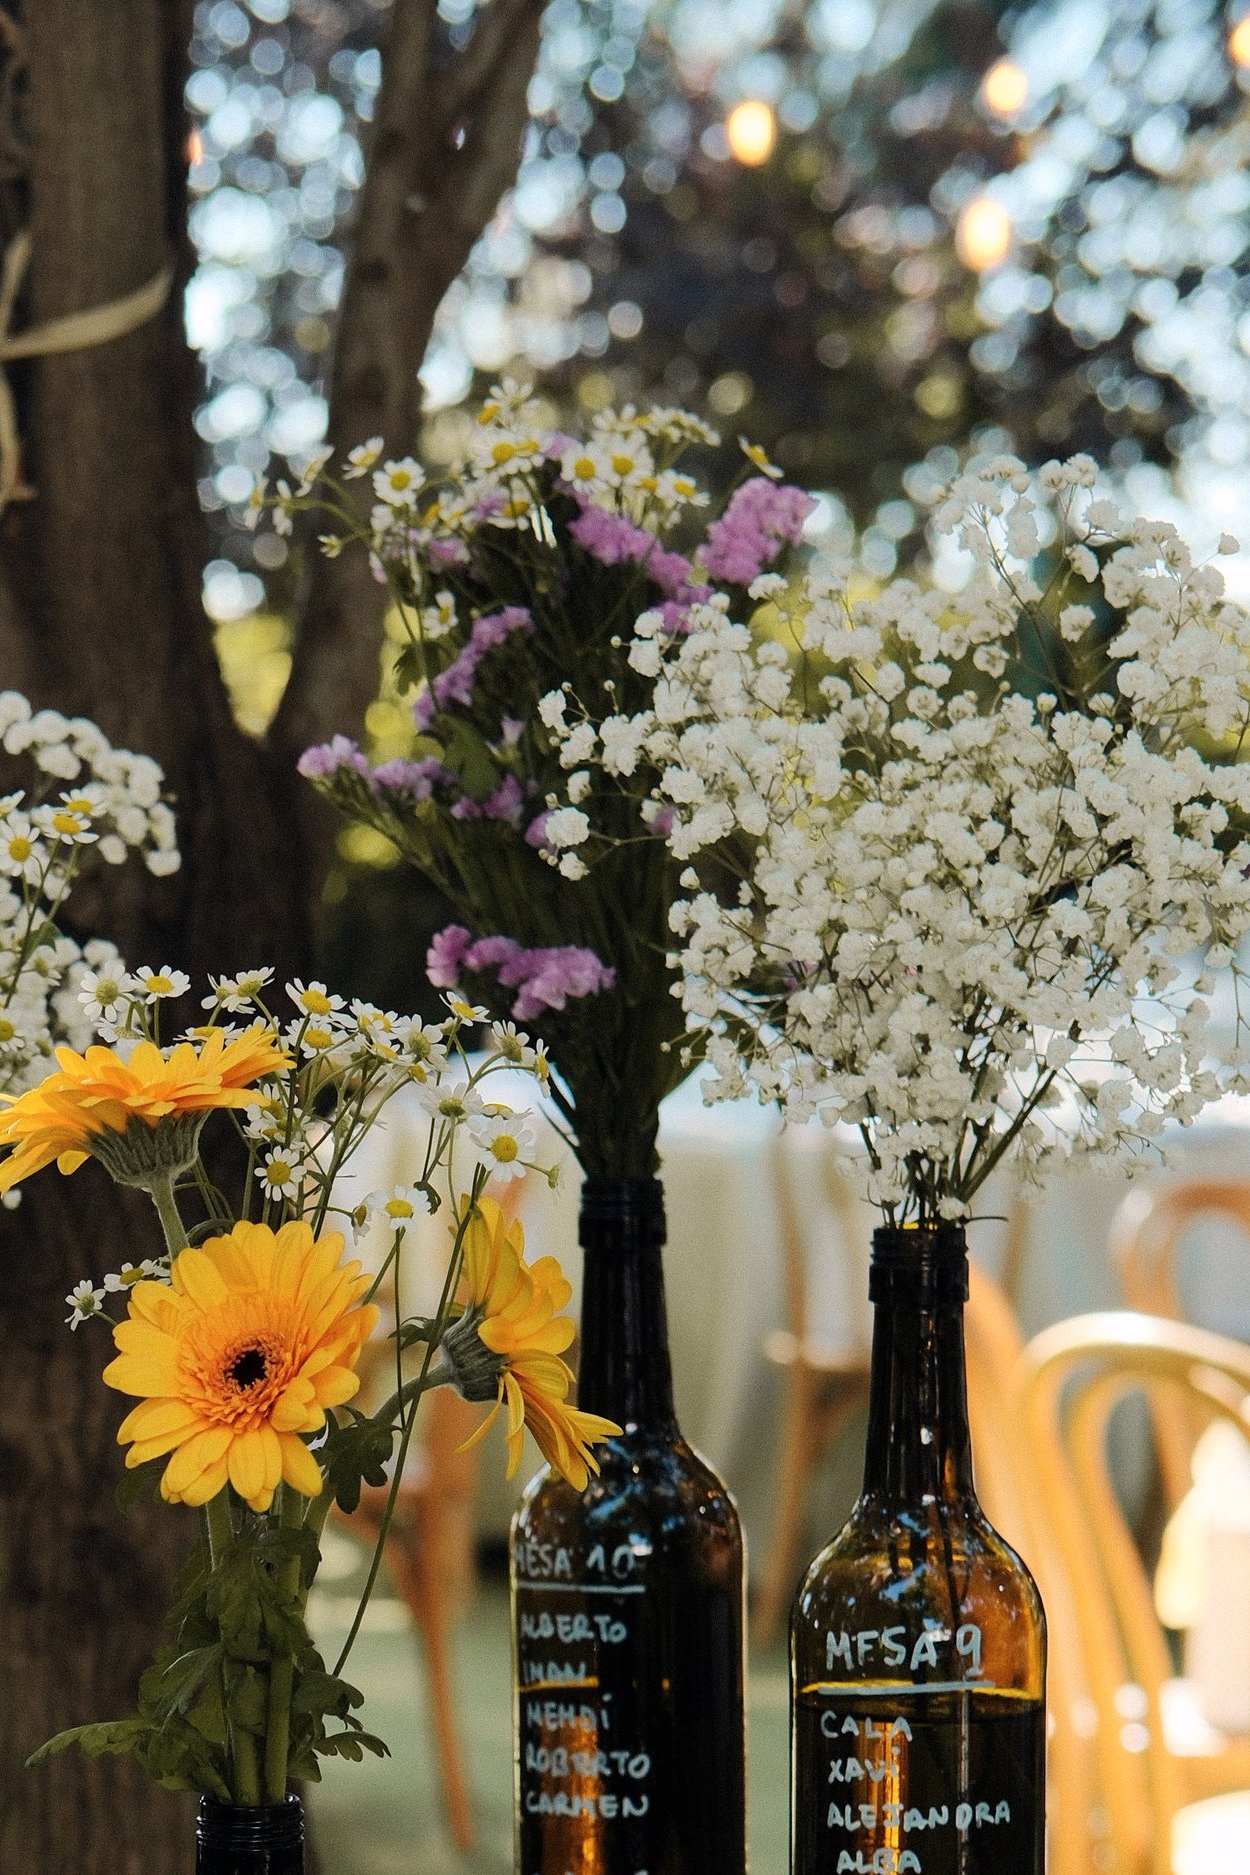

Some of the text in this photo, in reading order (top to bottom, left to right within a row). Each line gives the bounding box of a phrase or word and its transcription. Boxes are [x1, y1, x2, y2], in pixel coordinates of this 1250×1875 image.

[586, 1544, 635, 1578] 10
[956, 1624, 984, 1677] 9
[820, 1710, 912, 1741] CALA
[526, 1742, 650, 1779] ROBERTO
[828, 1746, 901, 1783] XAVi
[526, 1790, 649, 1820] CARMEN
[827, 1800, 1011, 1832] ALEJANDRA
[836, 1847, 922, 1875] ALBA
